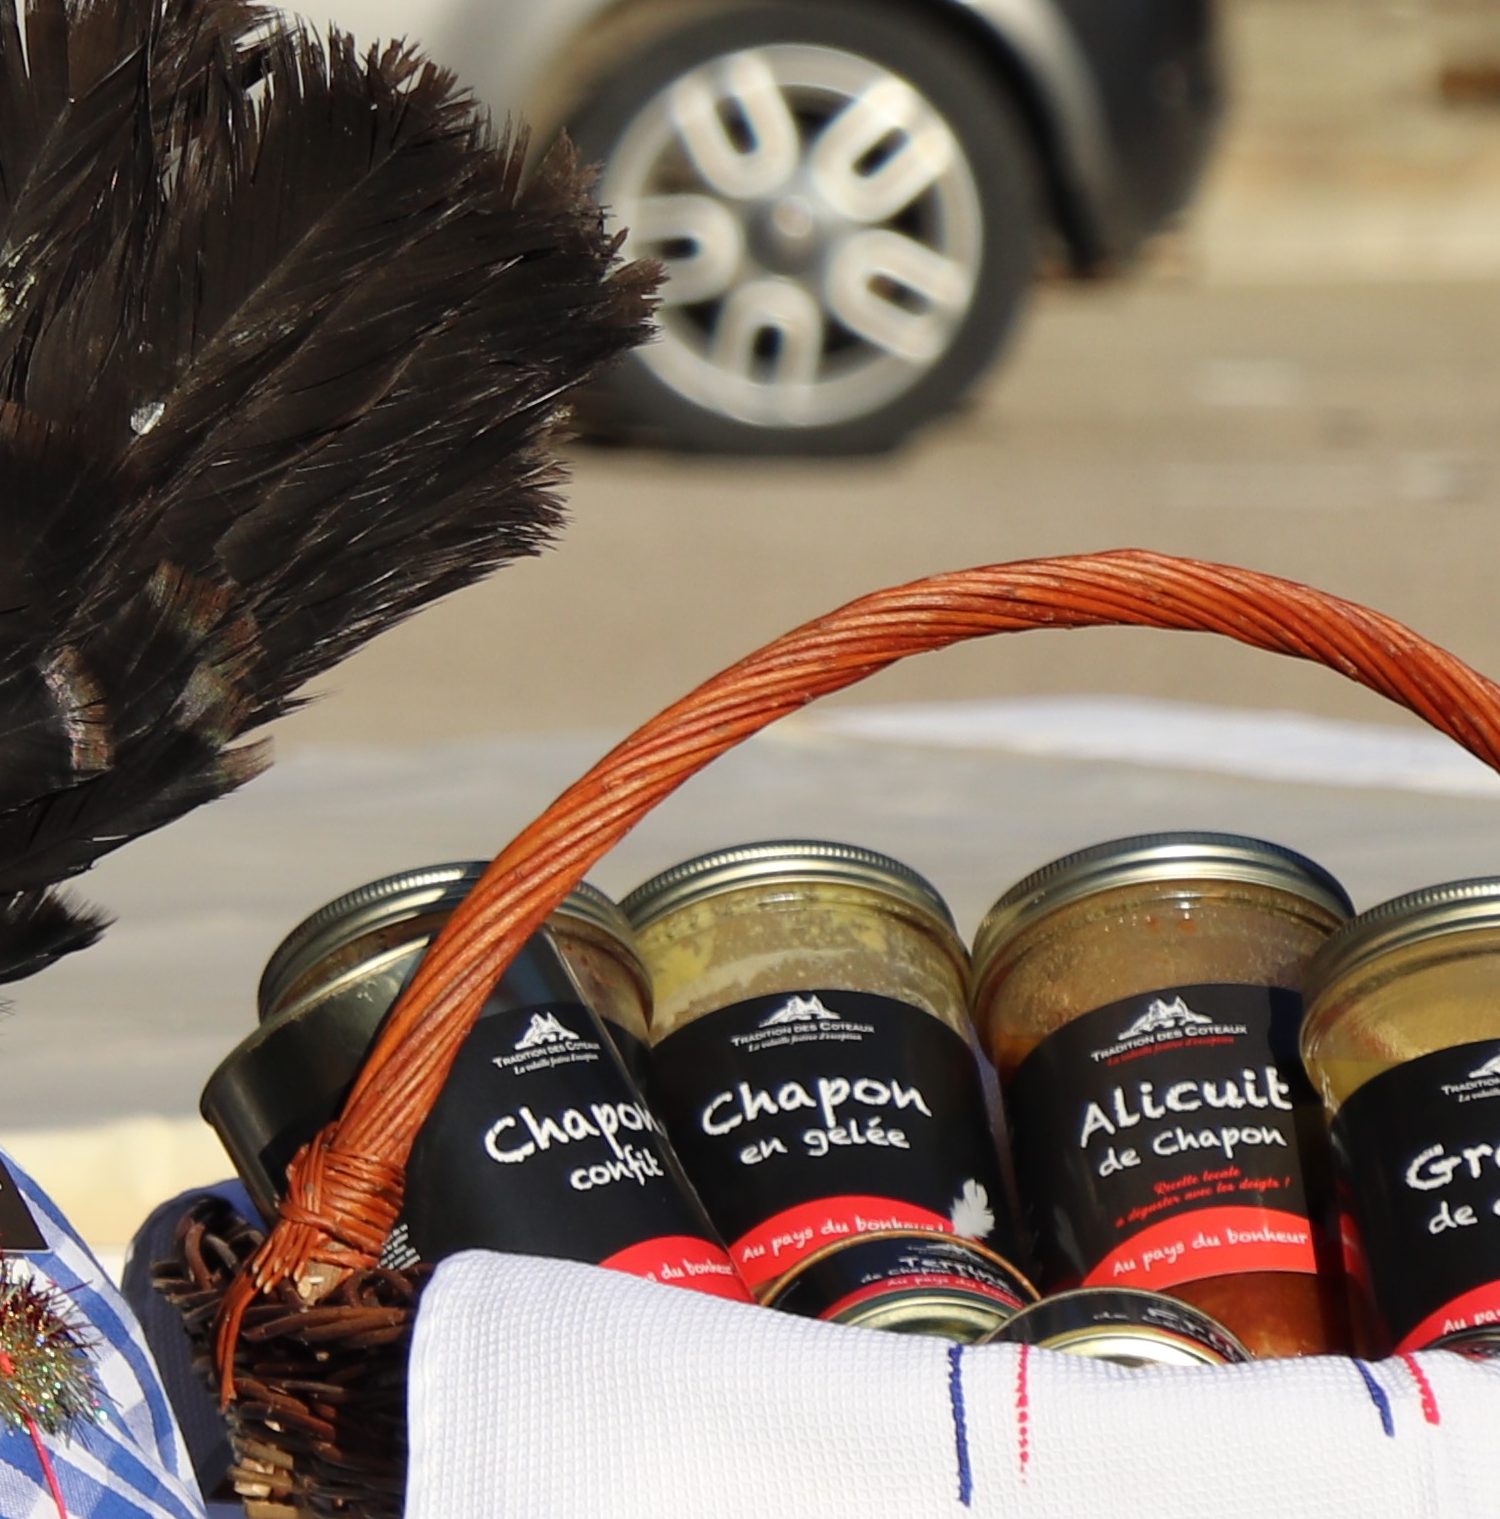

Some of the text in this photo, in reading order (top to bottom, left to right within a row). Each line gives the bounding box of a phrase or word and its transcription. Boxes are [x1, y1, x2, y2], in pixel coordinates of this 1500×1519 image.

[730, 1021, 875, 1047] TRADITION DES COTEAUX
[1091, 1024, 1248, 1062] TRADITION DES COTEAUX
[493, 1047, 547, 1069] TRADITION
[702, 1077, 932, 1136] Chapon
[1080, 1065, 1293, 1149] Alicuit
[484, 1101, 668, 1163] Chapon
[739, 1115, 910, 1164] en gelée
[1098, 1126, 1287, 1177] de Chapon
[570, 1144, 664, 1190] confit
[1406, 1142, 1500, 1191] Gr
[742, 1244, 766, 1263] Au
[772, 1227, 814, 1257] pays
[820, 1218, 850, 1234] du
[1428, 1200, 1479, 1235] de
[661, 1262, 684, 1280] du
[1113, 1226, 1308, 1277] Au pays du bonheur
[1442, 1318, 1468, 1335] Au
